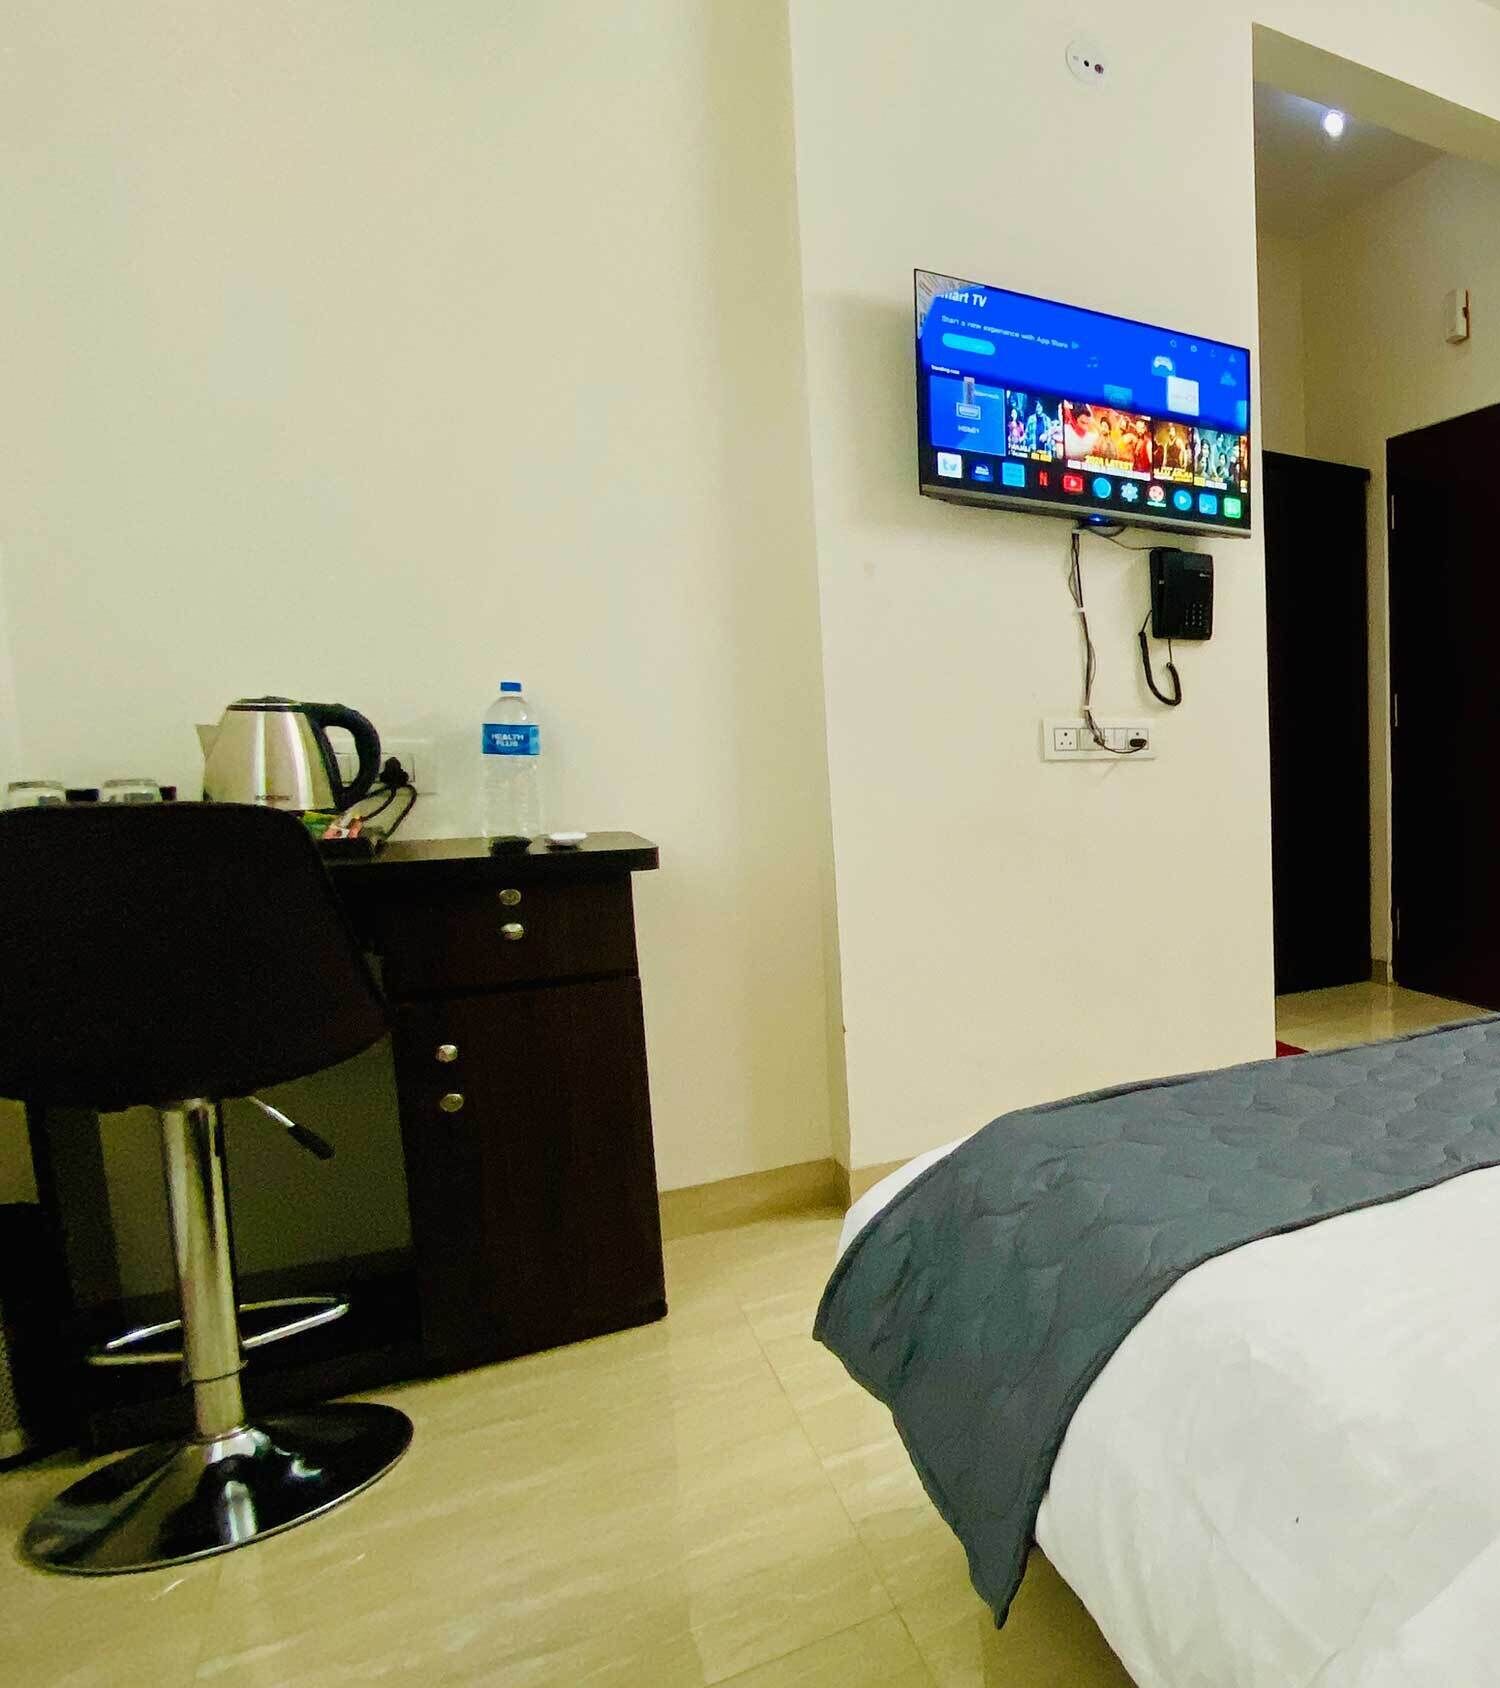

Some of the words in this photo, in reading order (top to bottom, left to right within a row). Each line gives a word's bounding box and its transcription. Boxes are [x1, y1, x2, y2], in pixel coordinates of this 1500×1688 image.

[973, 293, 988, 307] TV
[941, 315, 960, 325] Start
[983, 325, 1020, 338] experience
[1020, 333, 1036, 341] with
[1037, 335, 1050, 345] App
[1051, 339, 1069, 349] Store
